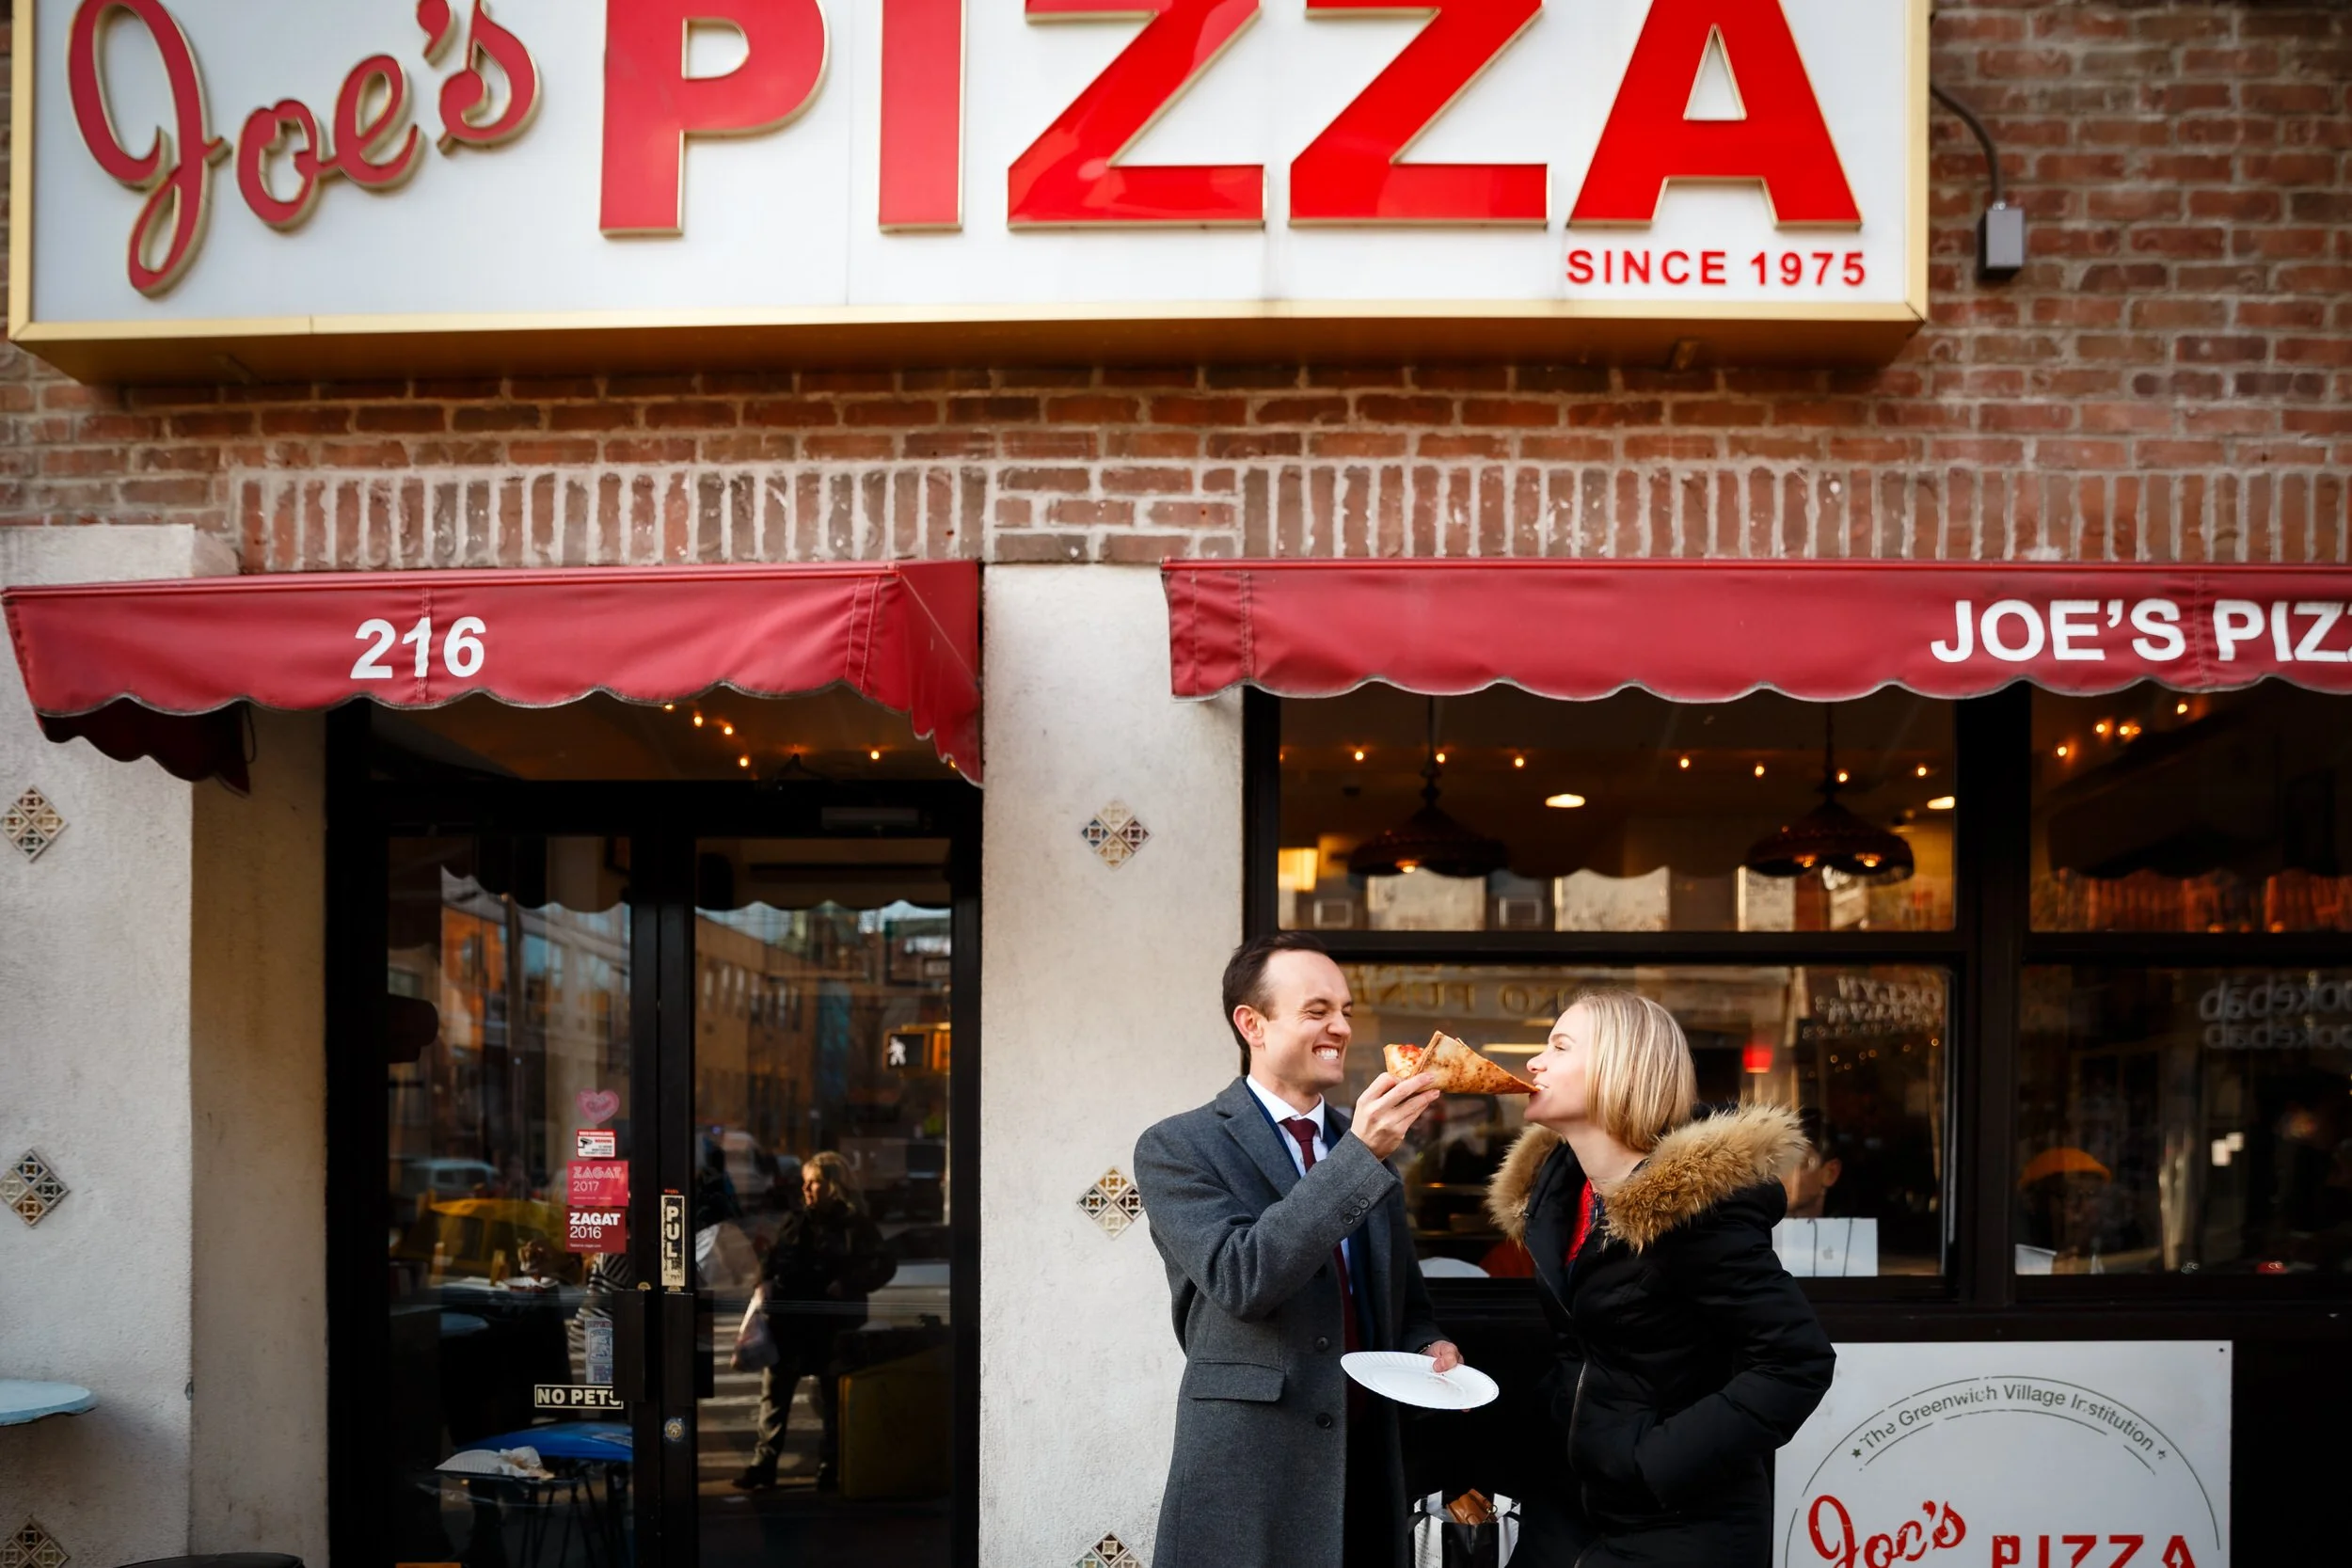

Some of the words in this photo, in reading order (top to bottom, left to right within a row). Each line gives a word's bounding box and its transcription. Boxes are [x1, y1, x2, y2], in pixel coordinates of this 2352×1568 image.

[68, 0, 541, 297] Joe's
[600, 0, 1863, 239] PIZZA
[1566, 249, 1726, 285] SINCE
[1750, 251, 1866, 286] 1975
[1931, 598, 2186, 663] JOE'S
[2213, 599, 2352, 662] PIZ
[350, 616, 486, 679] 216
[573, 1166, 622, 1180] ZAGAT
[573, 1181, 599, 1192] 2017
[569, 1212, 621, 1226] ZAGAT
[569, 1226, 602, 1239] 2016
[537, 1388, 565, 1404] NO
[1899, 1386, 1997, 1426] Greenwich
[2003, 1385, 2066, 1407] Village
[1992, 1535, 2197, 1568] PIZZA
